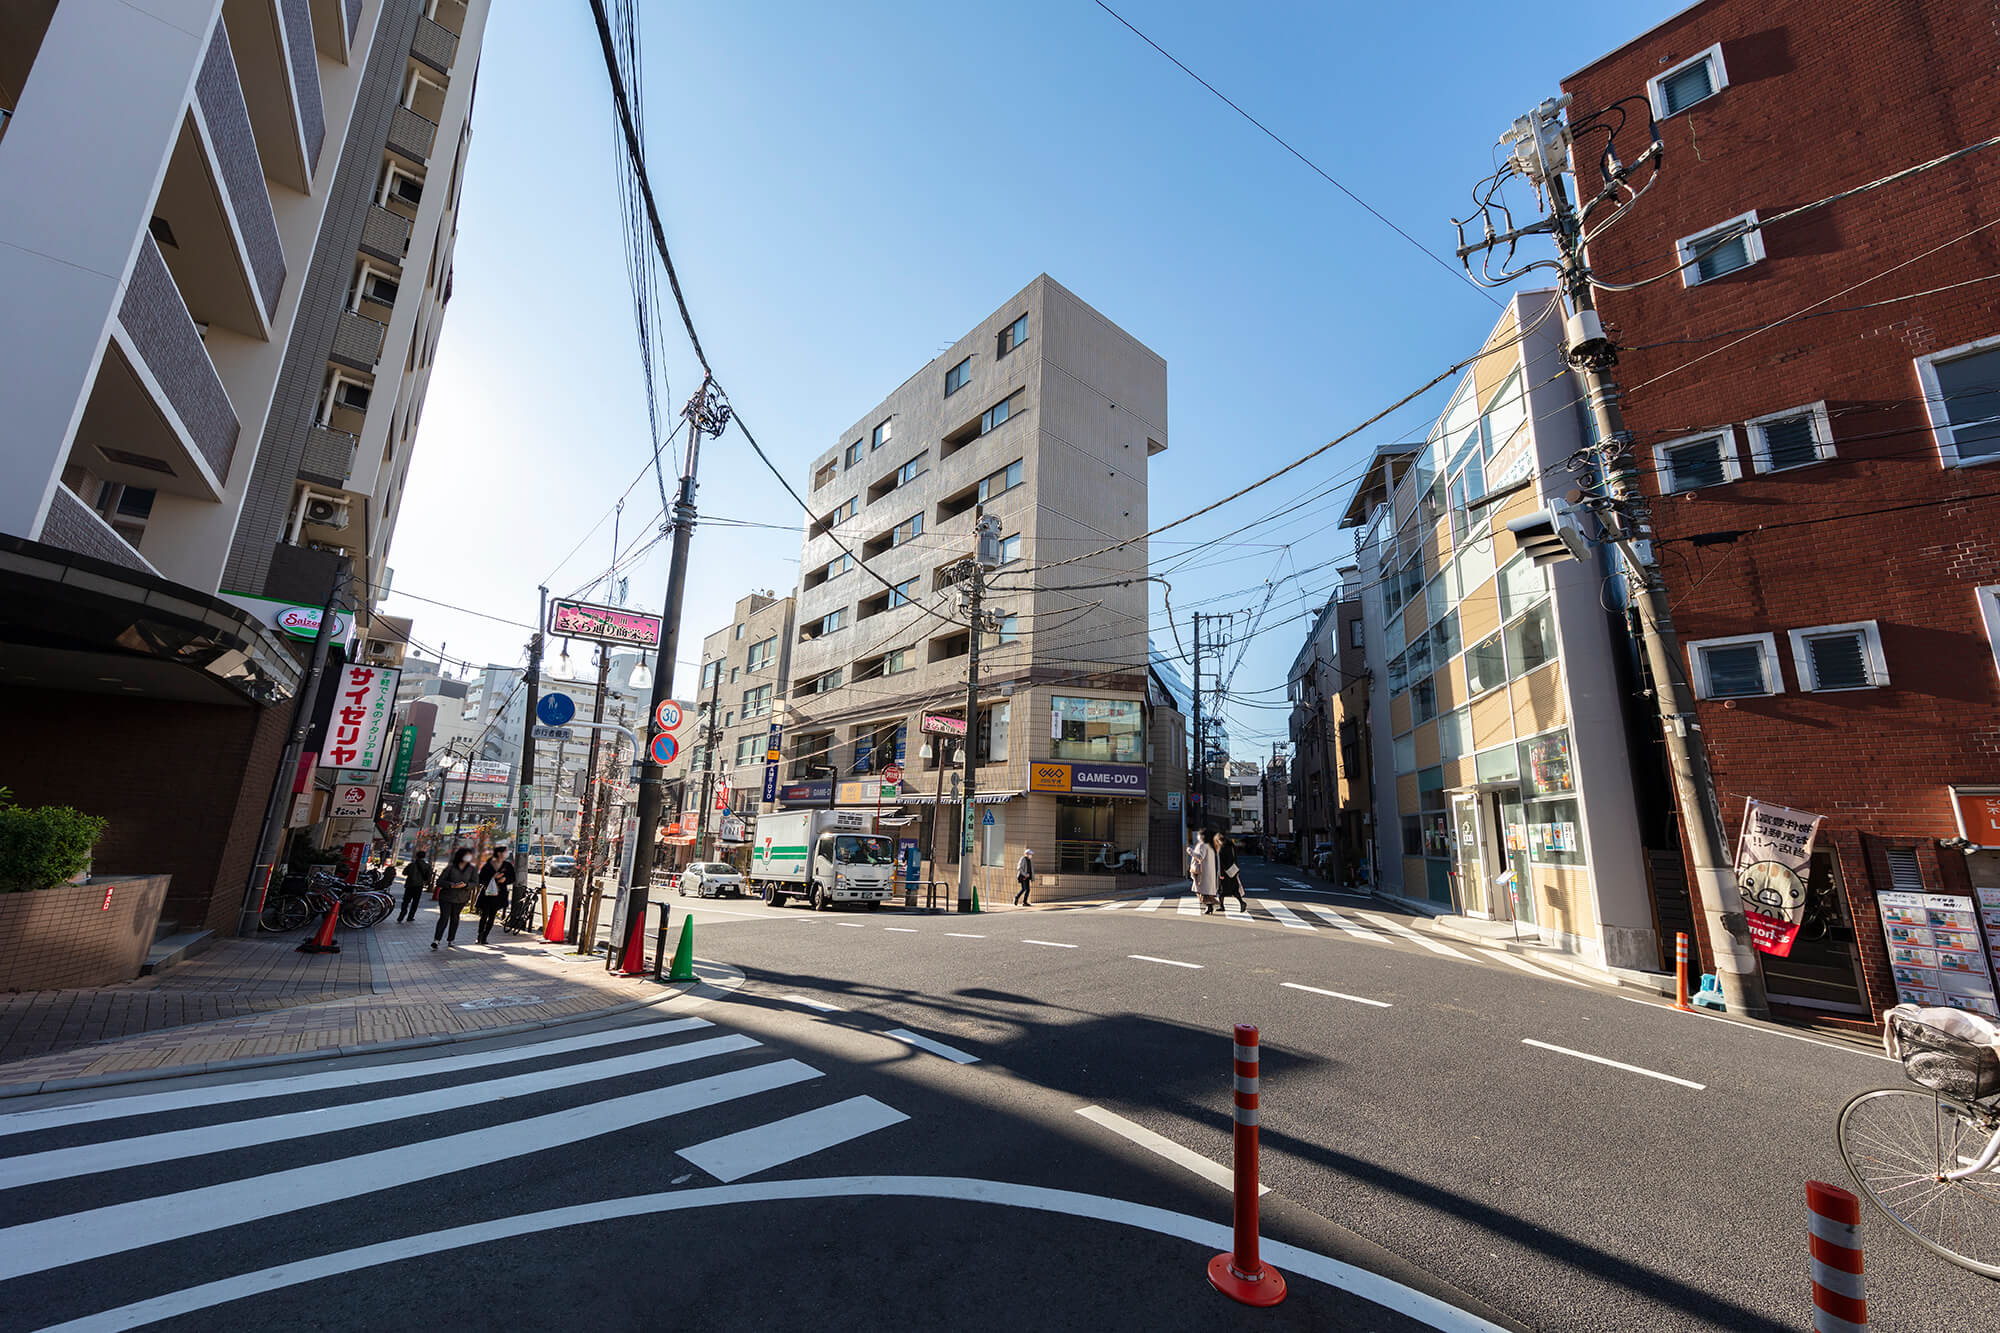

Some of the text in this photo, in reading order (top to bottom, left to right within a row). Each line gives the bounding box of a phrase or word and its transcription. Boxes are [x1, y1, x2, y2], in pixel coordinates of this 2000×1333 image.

[559, 617, 655, 642] さくら通り商栄会
[330, 667, 375, 766] サイゼリヤ
[362, 670, 393, 768] 手軽で人気のイタリア料理
[662, 708, 678, 724] 30
[535, 728, 570, 739] 歩行者優先
